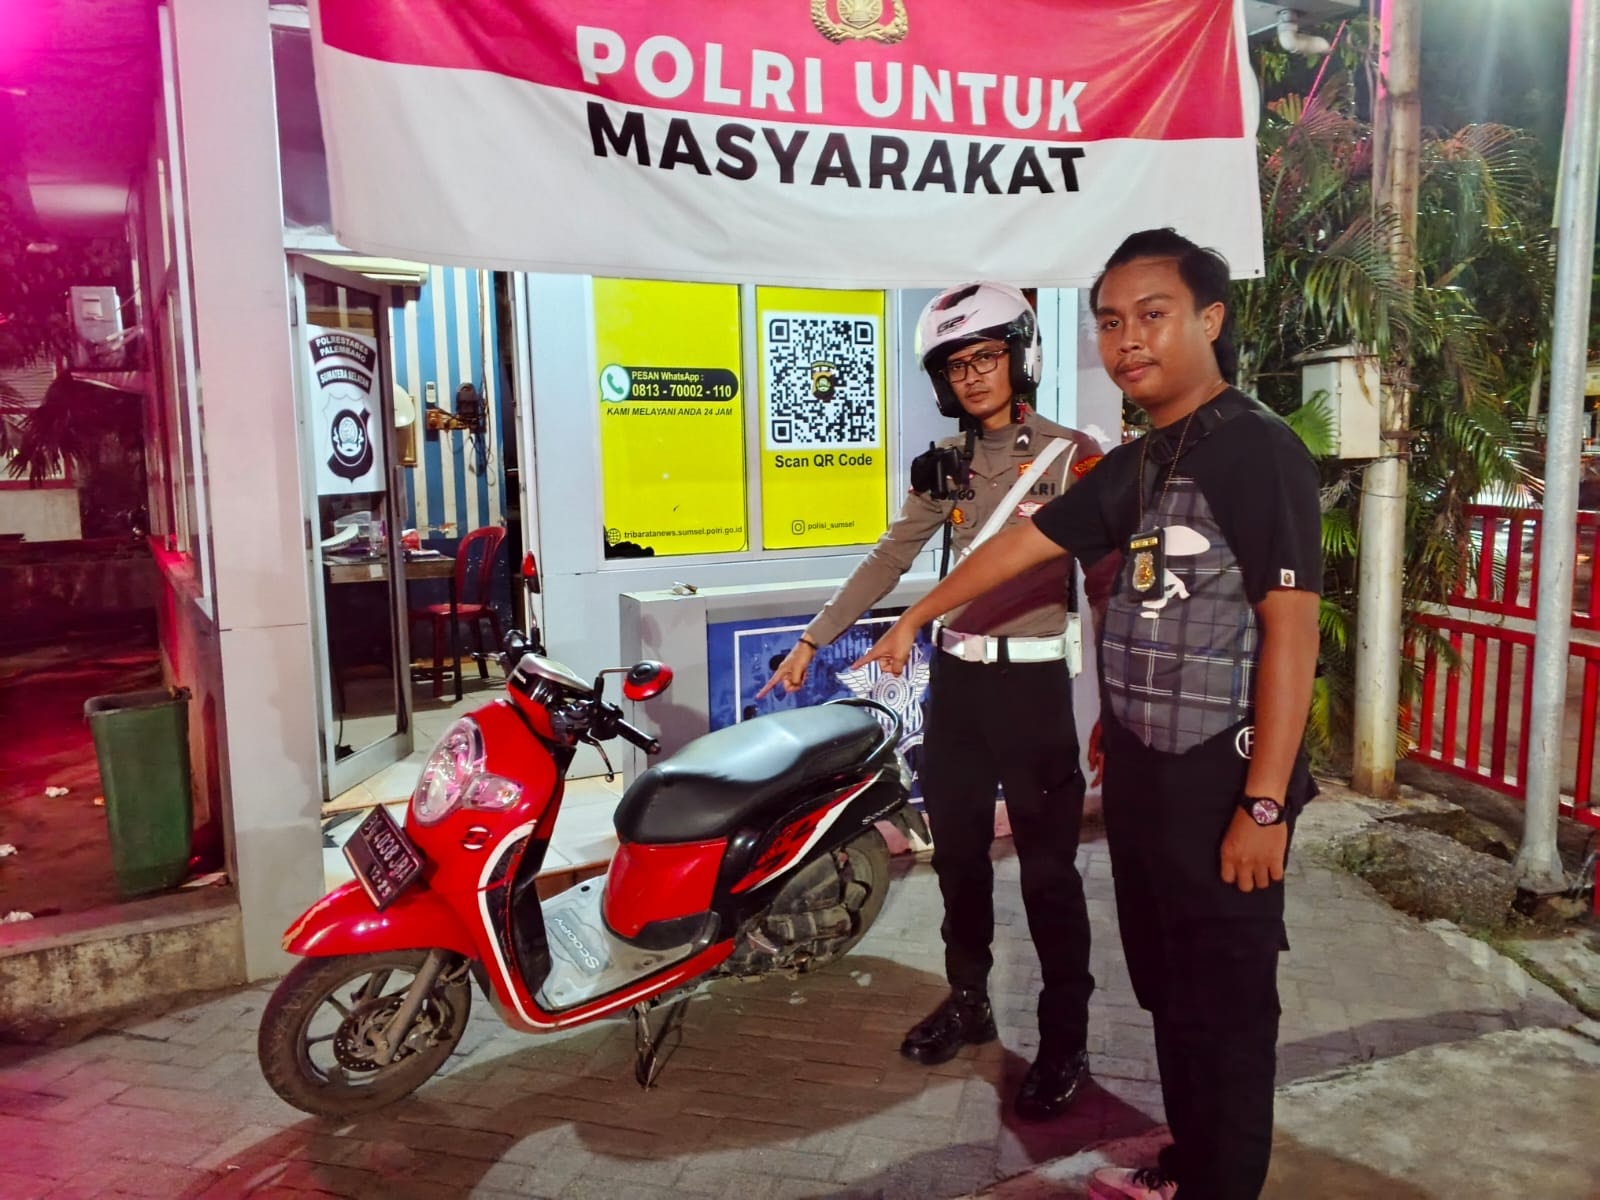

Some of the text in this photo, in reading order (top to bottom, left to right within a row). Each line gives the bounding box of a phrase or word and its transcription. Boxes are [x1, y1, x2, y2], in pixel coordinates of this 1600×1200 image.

[575, 25, 1089, 133] POLRI UNTUK
[586, 101, 1086, 195] MASYARAKAT
[315, 335, 369, 355] POLRESTABES
[319, 345, 367, 363] PALEMBANG
[631, 371, 659, 381] PESAN
[660, 371, 700, 383] WhatsApp
[632, 384, 660, 397] 0813
[670, 384, 703, 397] 70002
[713, 385, 732, 398] 110
[607, 407, 733, 416] KAMI MELAYANI ANDA 24 JAM
[774, 453, 873, 468] Scan QR Code
[807, 520, 855, 531] polisi_sumsel
[374, 828, 400, 861] 4038
[553, 918, 600, 969] Scoopy
